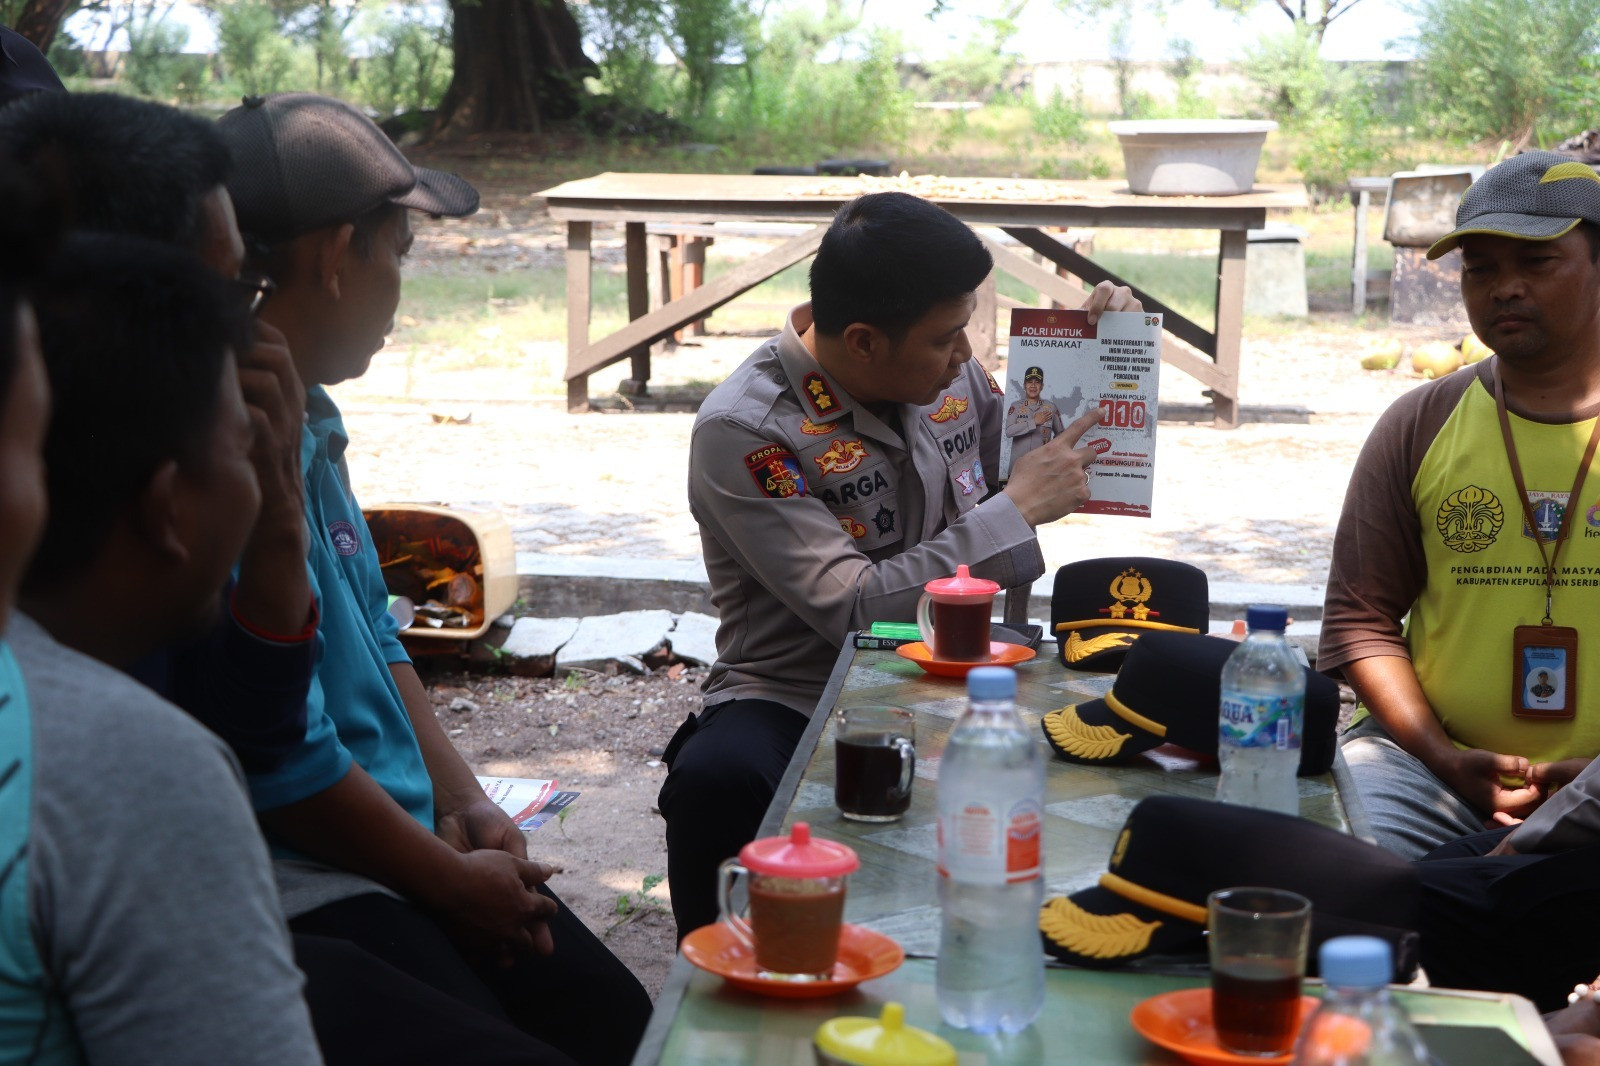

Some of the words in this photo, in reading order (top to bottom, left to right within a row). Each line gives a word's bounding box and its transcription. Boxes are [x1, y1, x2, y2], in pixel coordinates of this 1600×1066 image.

[1021, 326, 1048, 336] POLRI
[1051, 327, 1083, 337] UNTUK
[1020, 338, 1083, 349] MASYARAKAT
[943, 424, 977, 460] POLRI
[751, 446, 786, 462] PROPA
[1105, 459, 1135, 467] DIPUNGUT
[1136, 460, 1152, 468] BIAYA
[823, 470, 889, 506] ARGA
[1451, 566, 1522, 575] PENGABDIAN
[1456, 577, 1510, 586] KABUPATEN
[1511, 578, 1568, 587] KEPULAAN
[1571, 578, 1600, 587] SERIB
